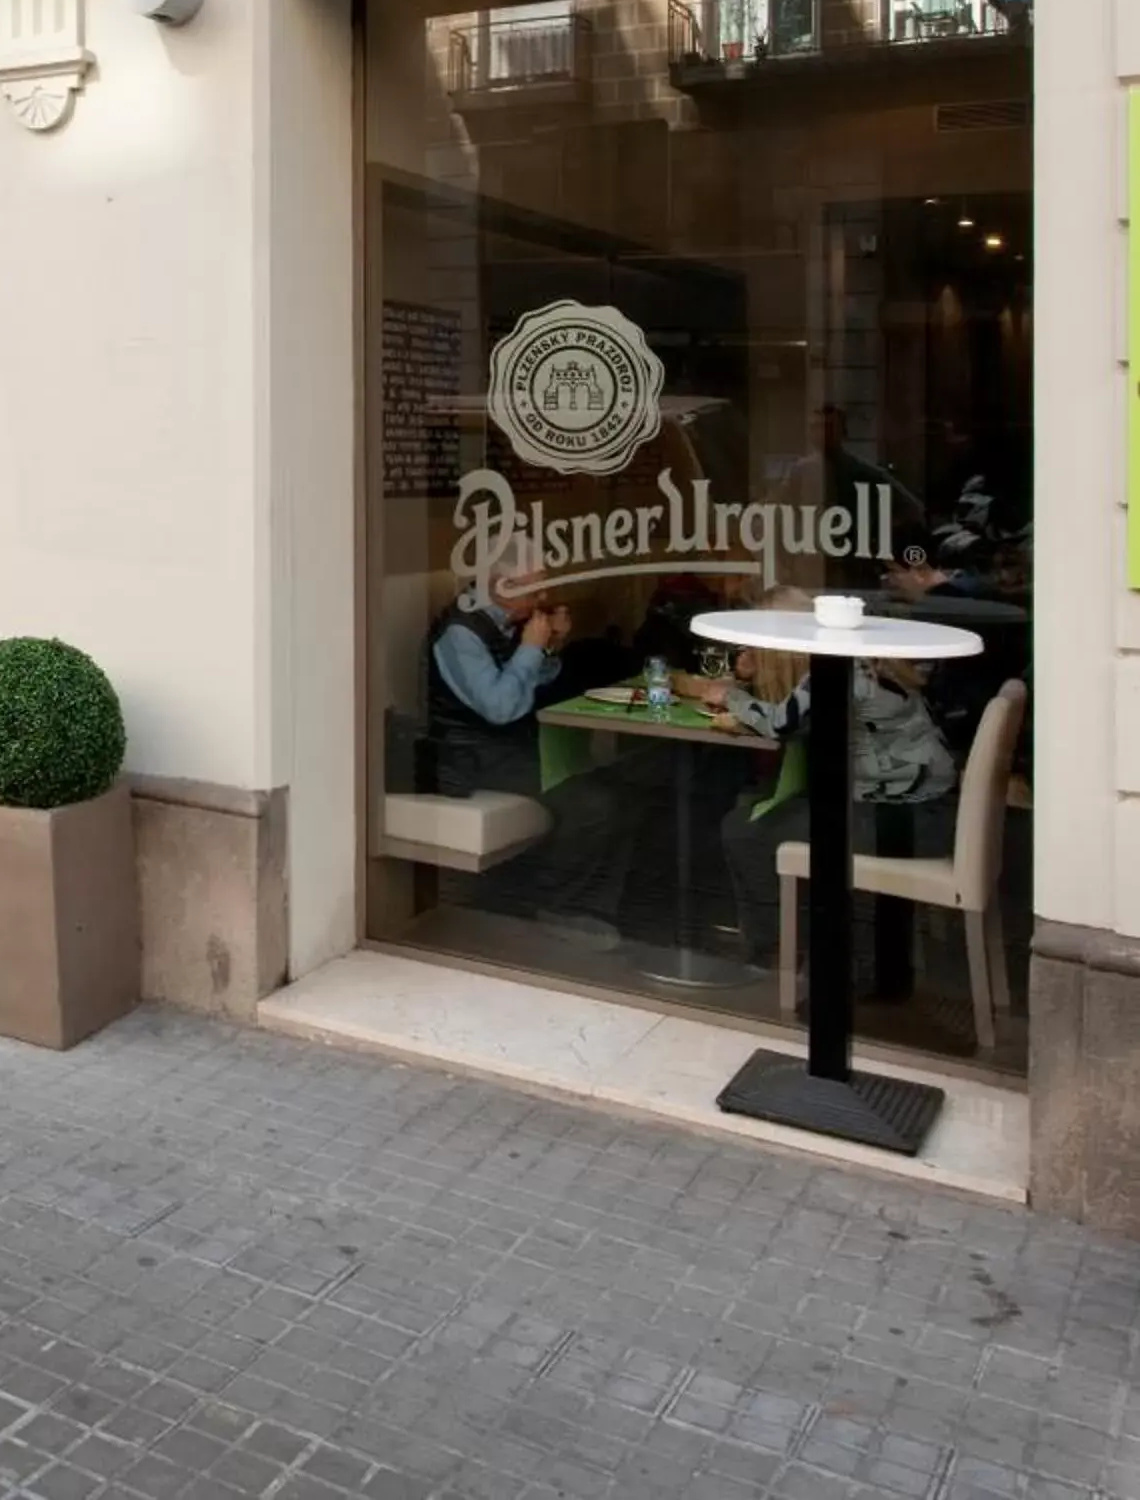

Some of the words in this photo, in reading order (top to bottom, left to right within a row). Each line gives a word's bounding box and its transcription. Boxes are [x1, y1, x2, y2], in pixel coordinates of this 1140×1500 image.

[575, 331, 633, 393] PRAZDROJ
[525, 412, 543, 433] OD
[545, 430, 587, 447] ROKU
[590, 412, 624, 443] 1842
[450, 468, 665, 611] Pilsner
[657, 468, 895, 592] Urquell
